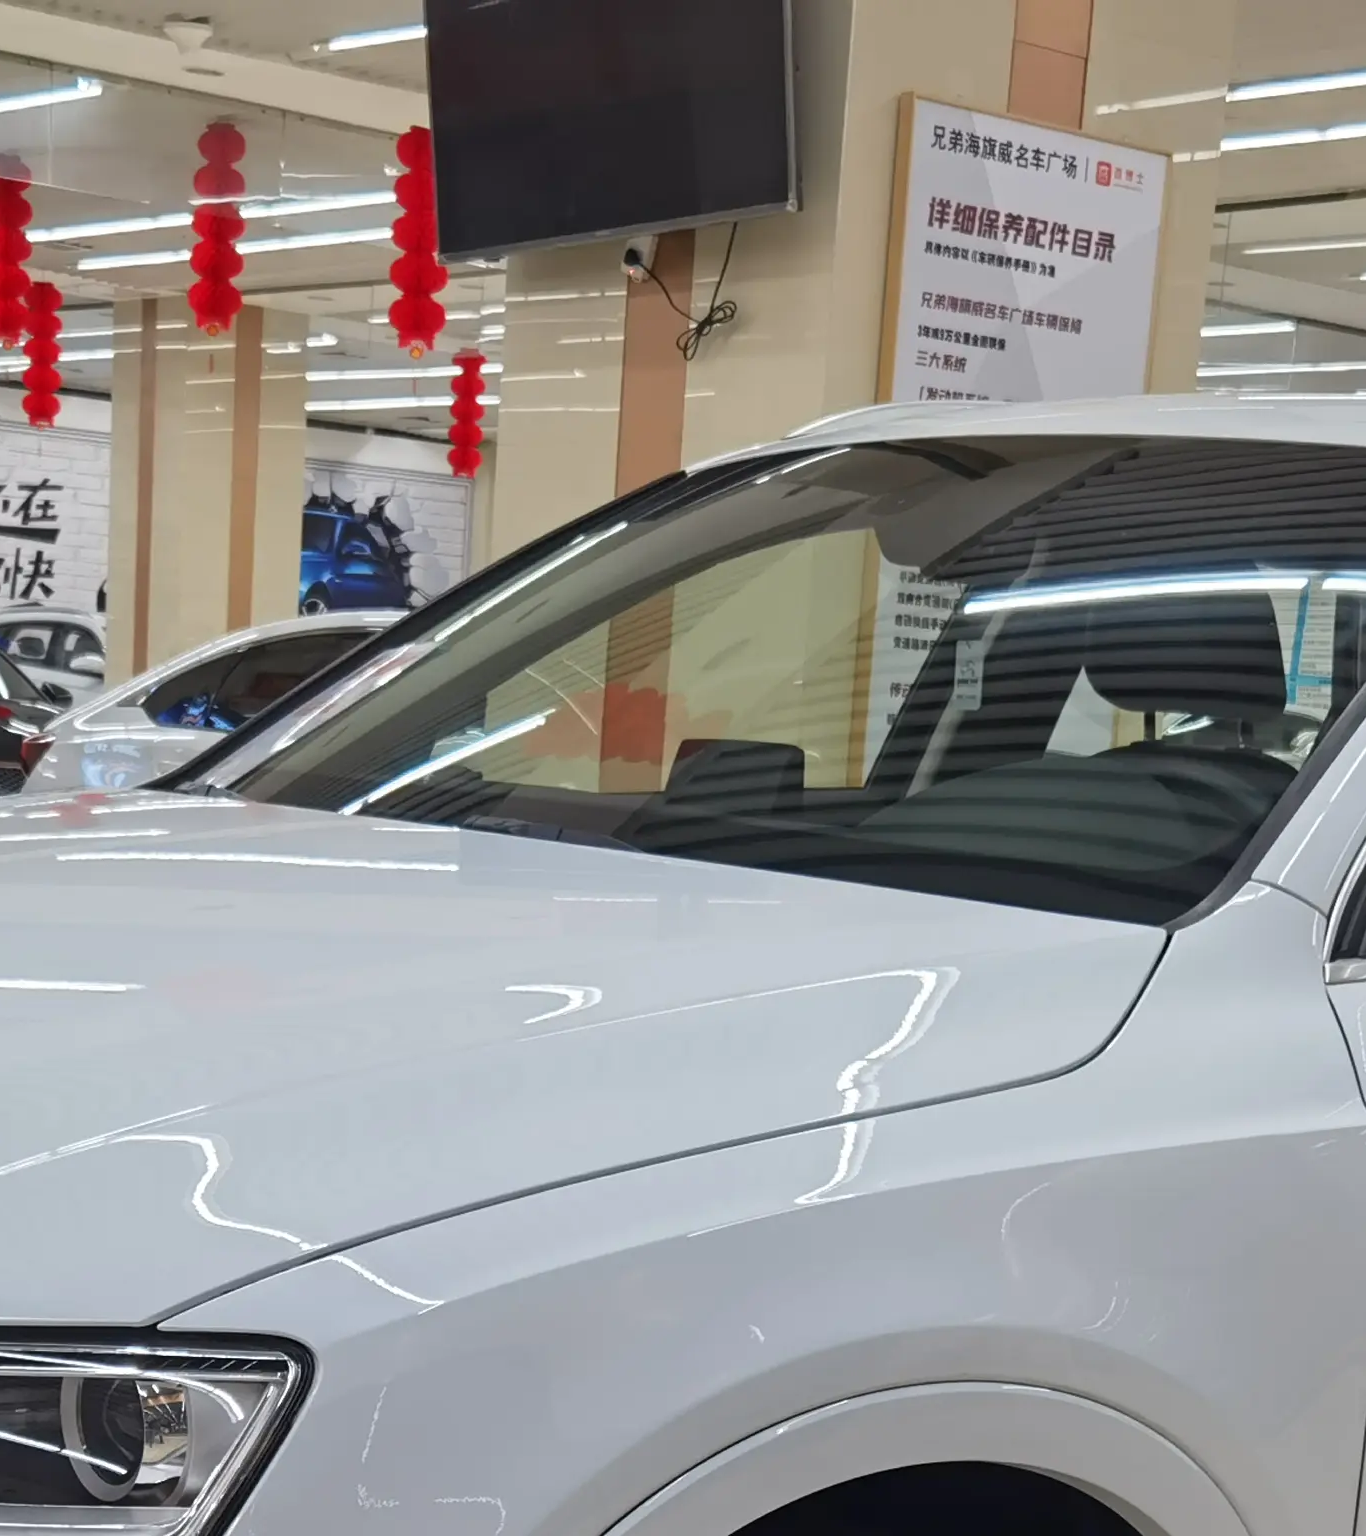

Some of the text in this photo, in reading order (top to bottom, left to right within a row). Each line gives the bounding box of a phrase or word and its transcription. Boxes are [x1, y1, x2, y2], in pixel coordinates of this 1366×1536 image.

[931, 125, 1078, 180] 兄弟海旗威名车广场
[927, 196, 1116, 263] 详细保养配件目录
[914, 350, 968, 373] 三大系统
